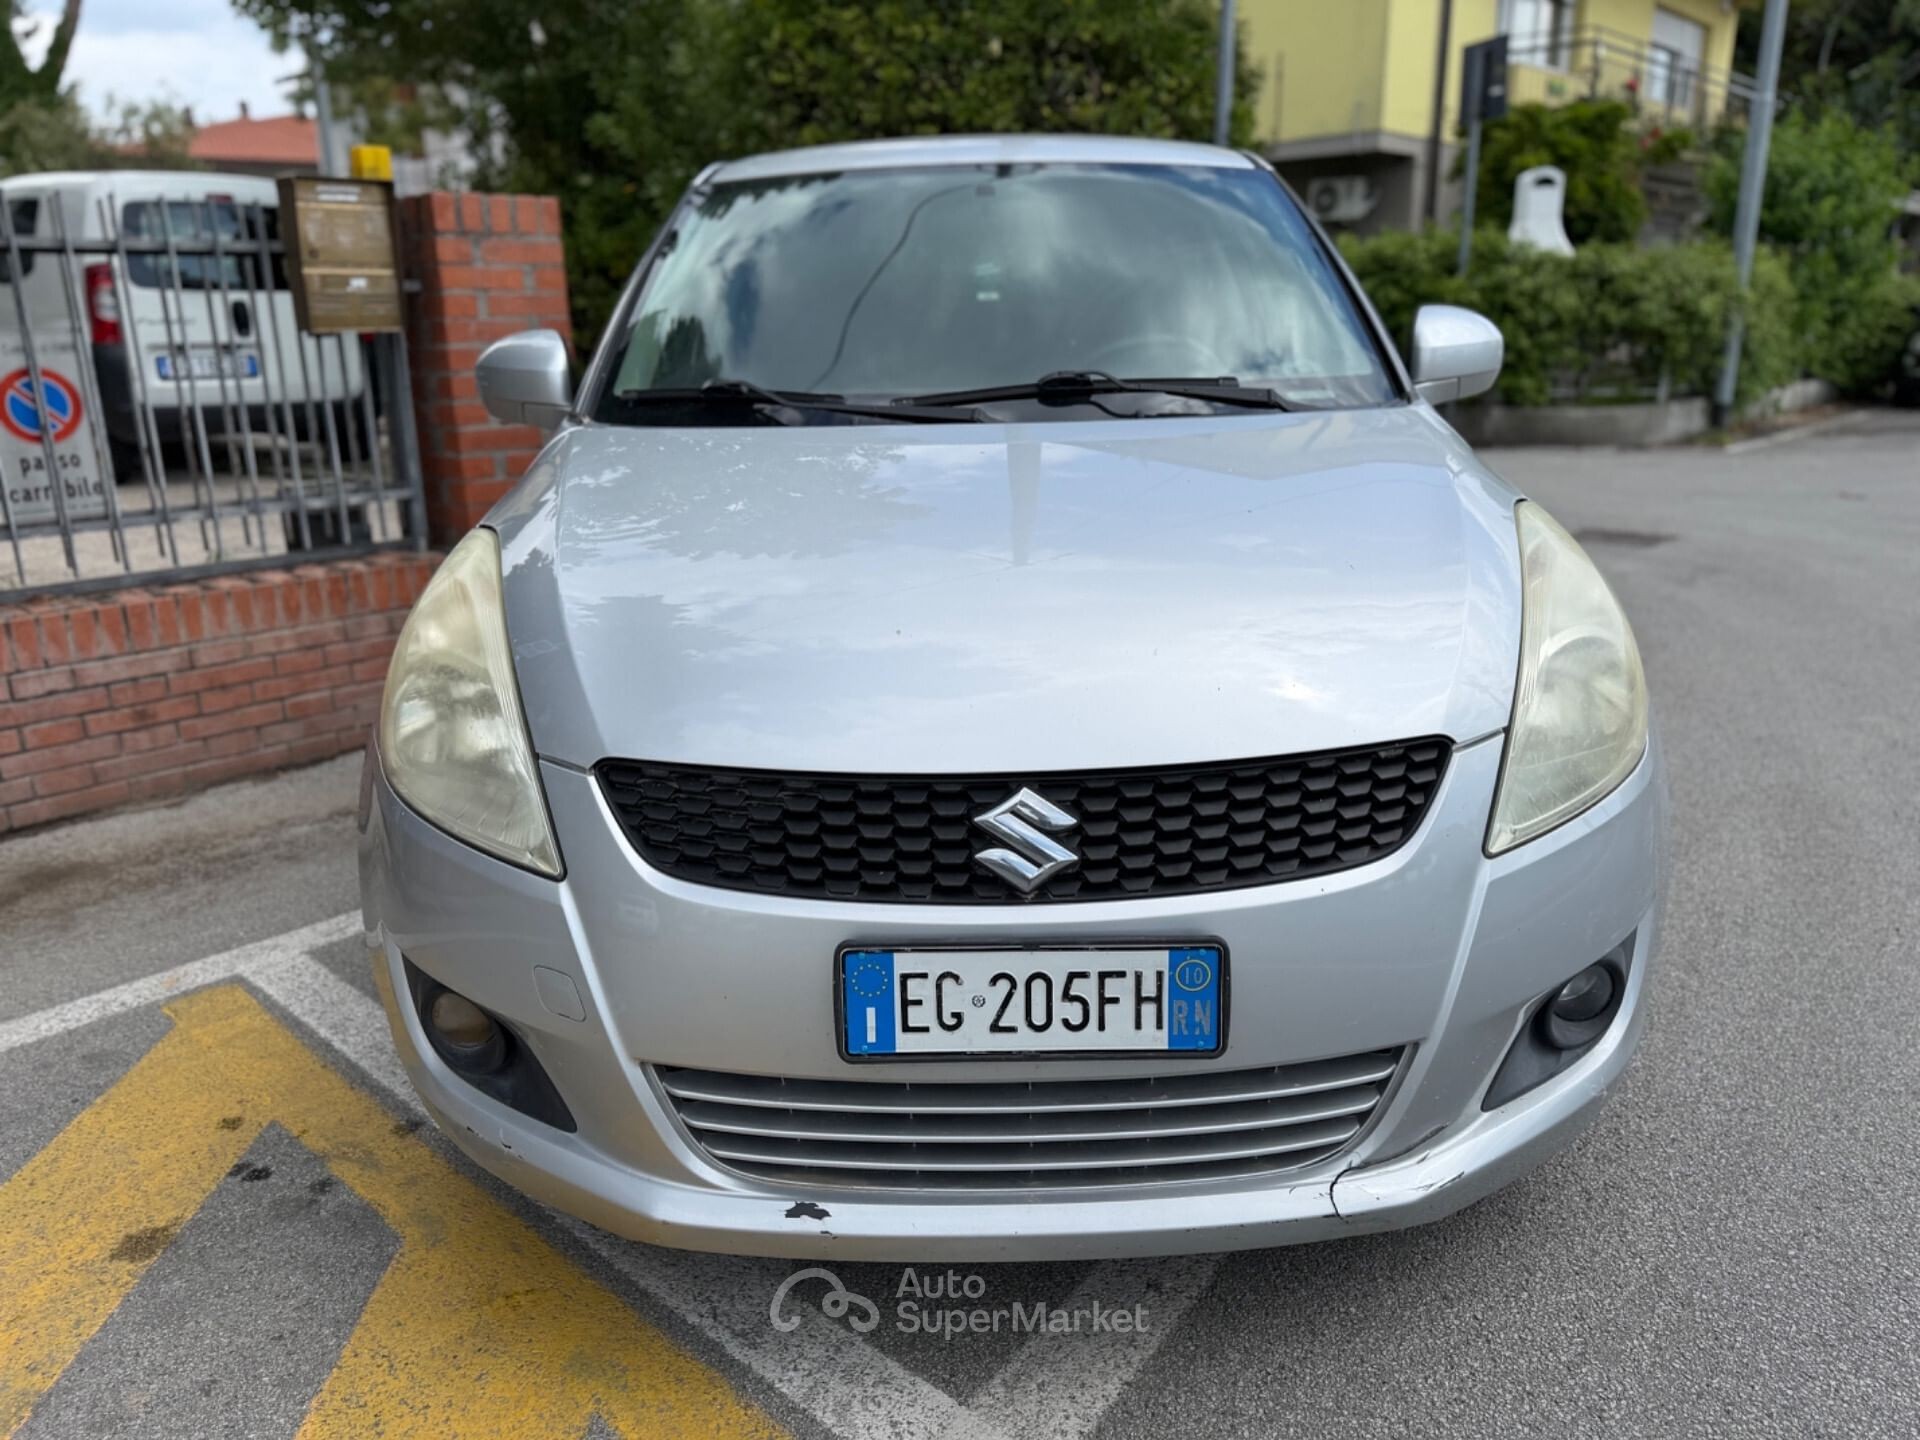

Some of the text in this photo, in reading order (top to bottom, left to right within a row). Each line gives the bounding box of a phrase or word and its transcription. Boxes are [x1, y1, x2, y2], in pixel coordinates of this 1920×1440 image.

[19, 453, 81, 478] paso
[9, 476, 103, 503] carrbile
[900, 970, 1164, 1034] EG 205FH
[1172, 1000, 1211, 1036] RN
